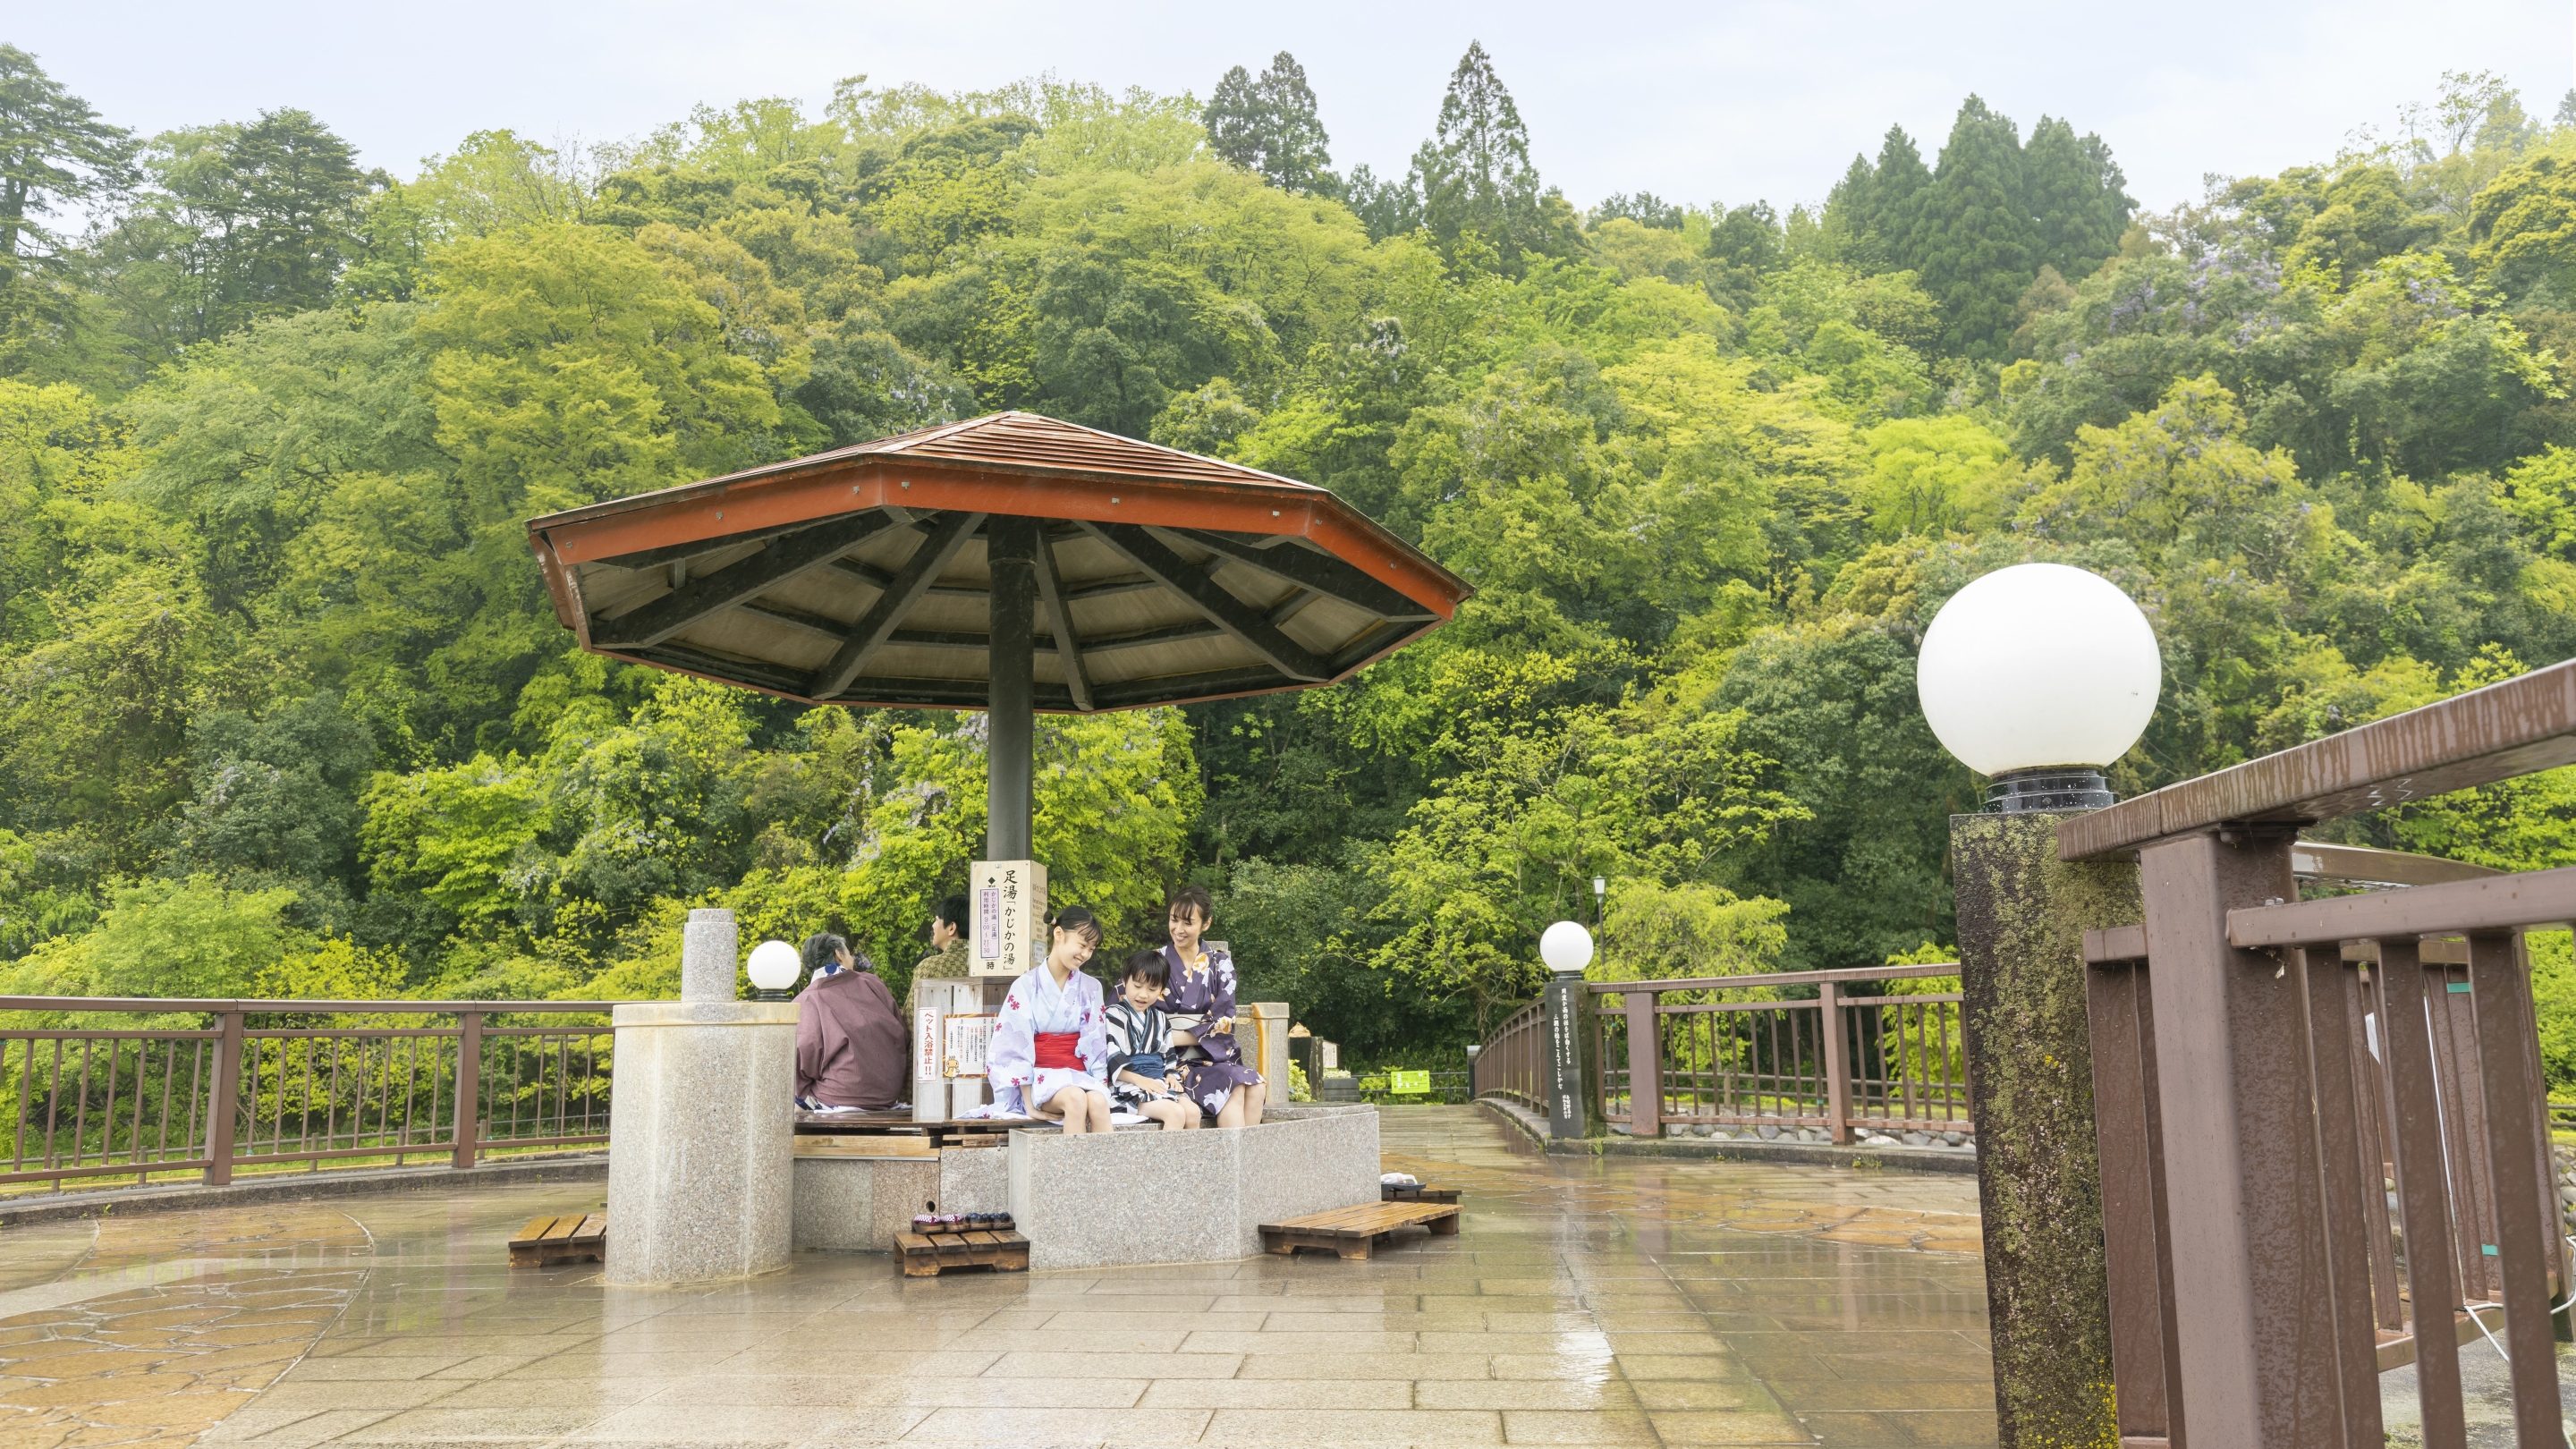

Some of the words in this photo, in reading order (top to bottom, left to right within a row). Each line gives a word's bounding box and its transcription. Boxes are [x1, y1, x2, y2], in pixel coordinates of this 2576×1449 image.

[1003, 869, 1018, 970] 足湯「かじかの湯」
[986, 961, 995, 970] 時
